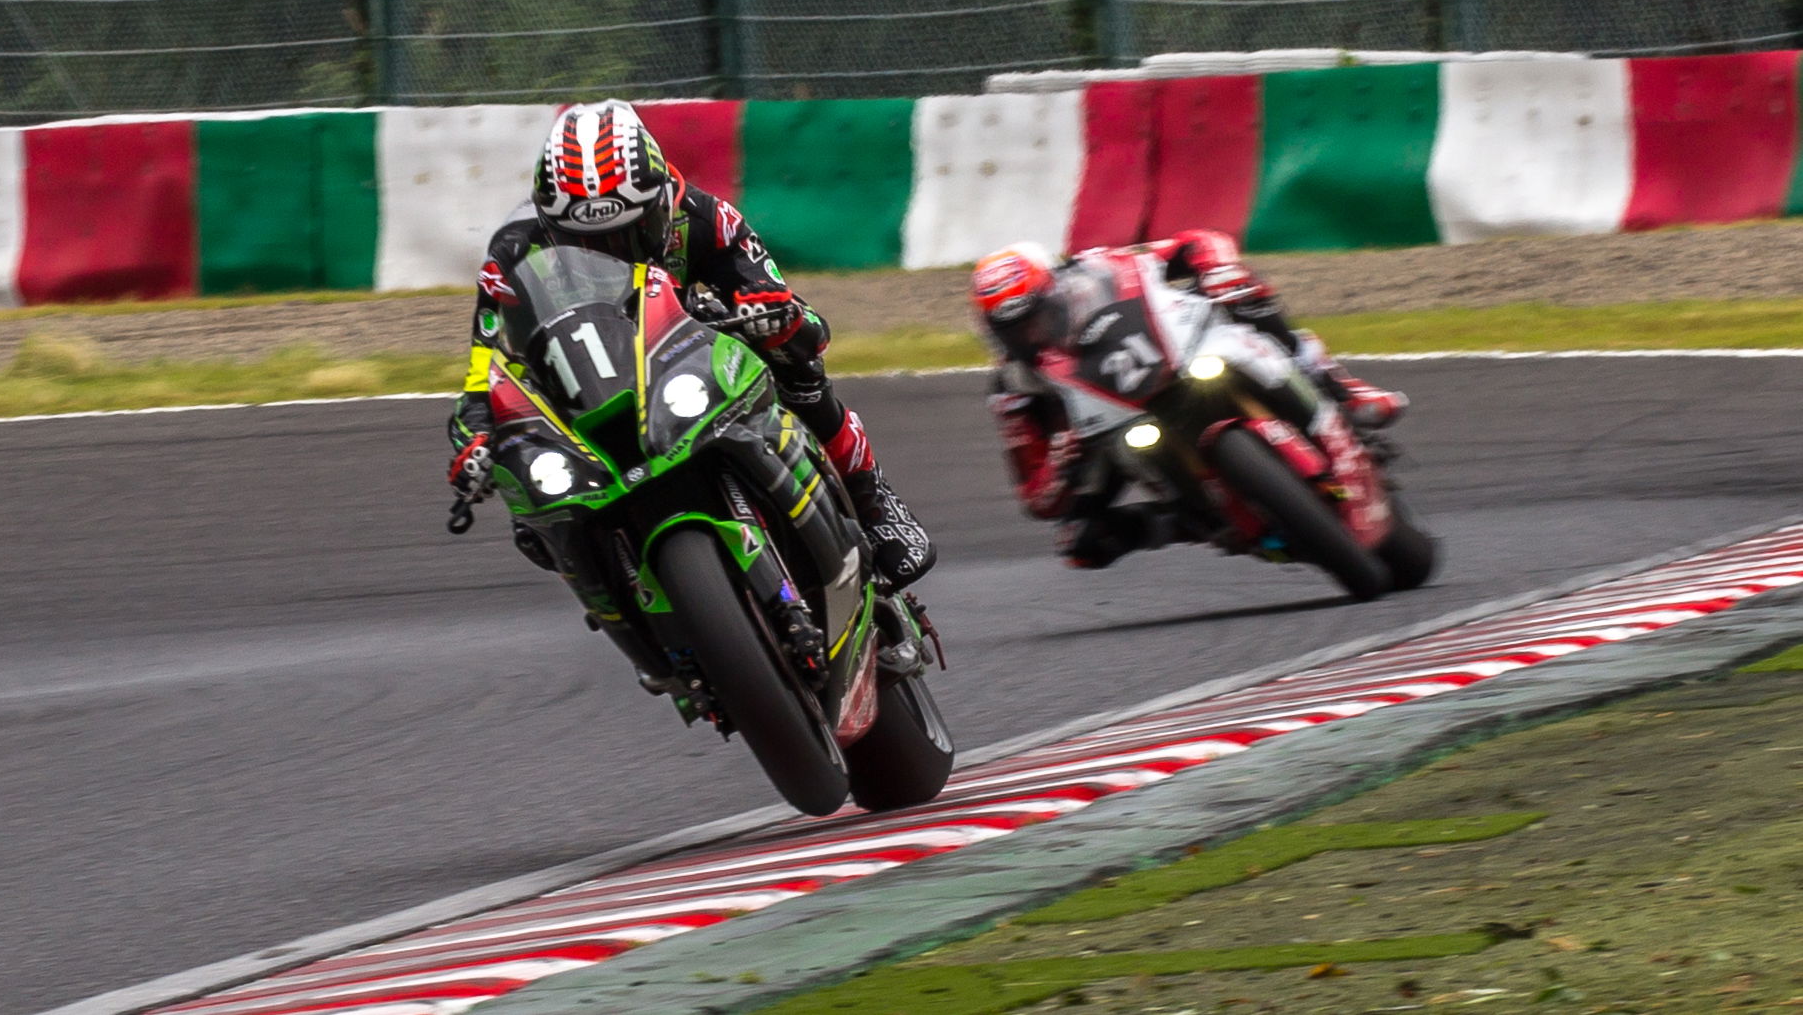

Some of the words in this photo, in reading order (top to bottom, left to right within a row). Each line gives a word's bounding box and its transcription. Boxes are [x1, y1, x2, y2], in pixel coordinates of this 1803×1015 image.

[575, 202, 616, 222] Arai
[543, 321, 618, 399] 11
[1100, 332, 1164, 393] 21
